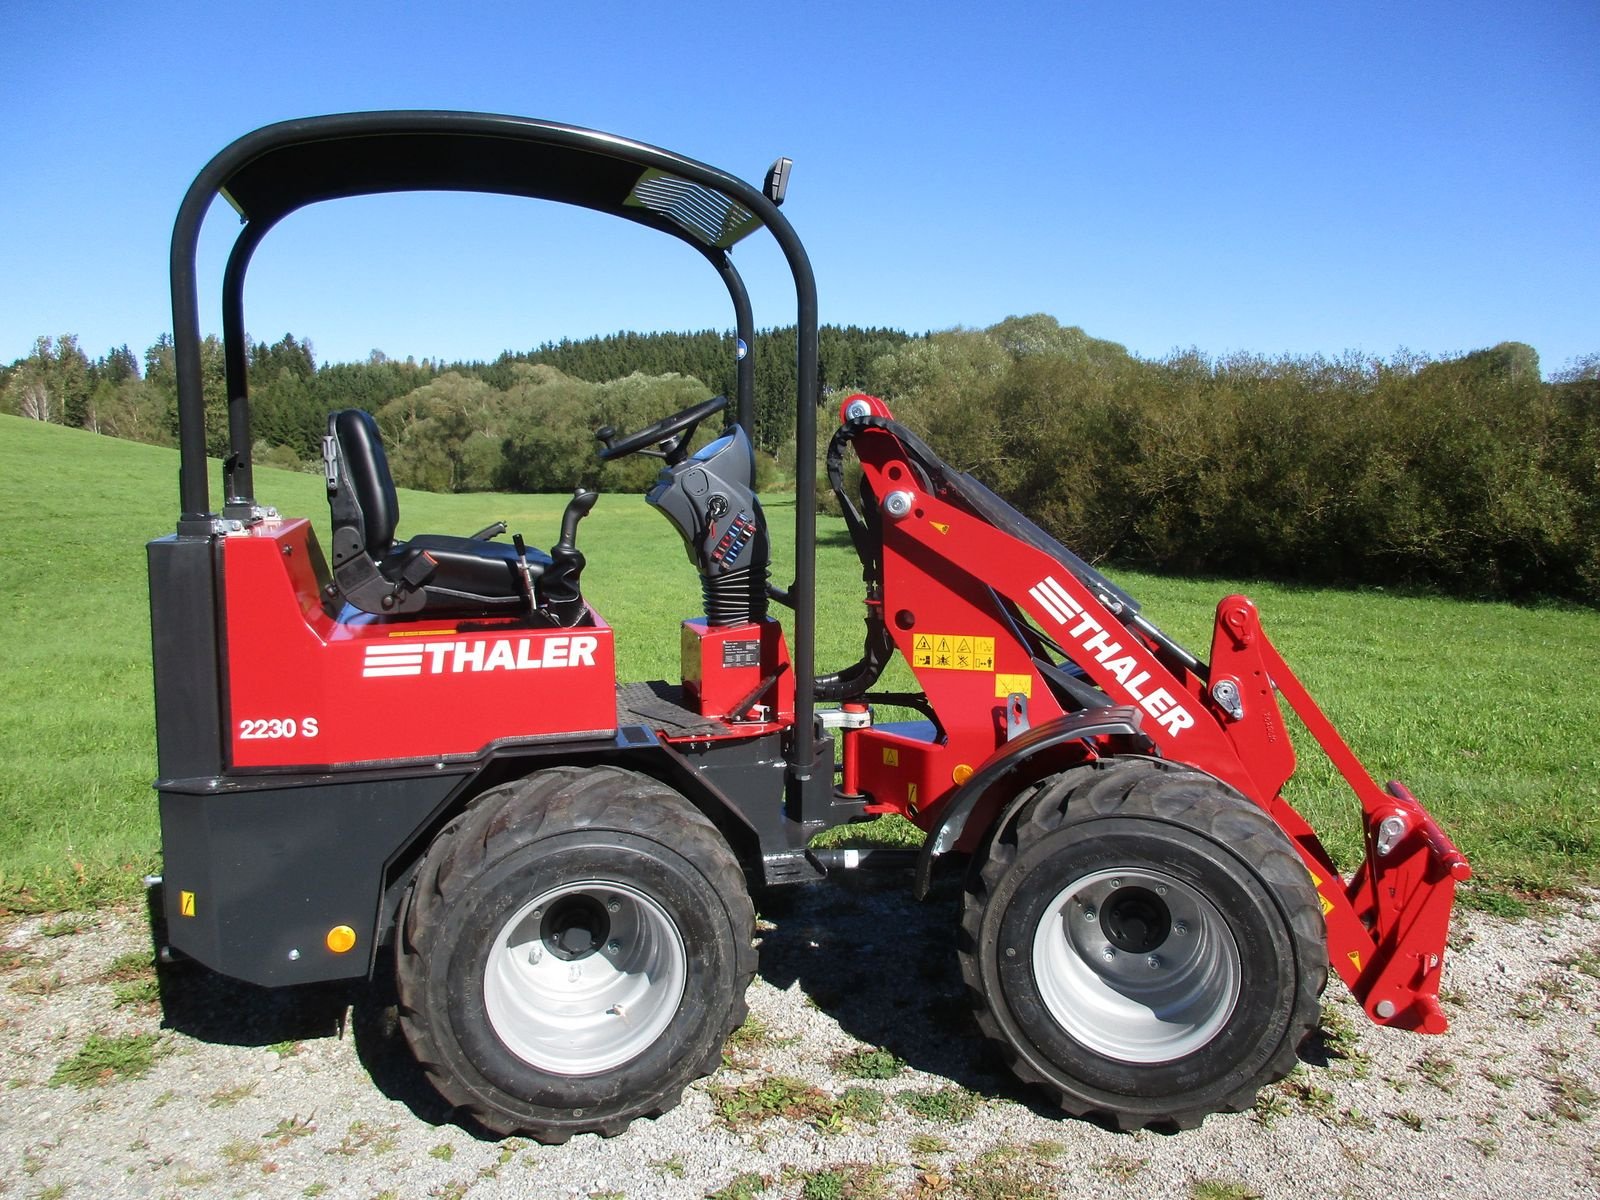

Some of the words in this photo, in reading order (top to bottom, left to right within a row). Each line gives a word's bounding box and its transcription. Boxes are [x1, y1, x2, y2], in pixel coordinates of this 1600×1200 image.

[423, 636, 598, 674] THALER
[1068, 611, 1195, 738] THALER
[240, 718, 297, 739] 2230
[301, 717, 319, 738] S
